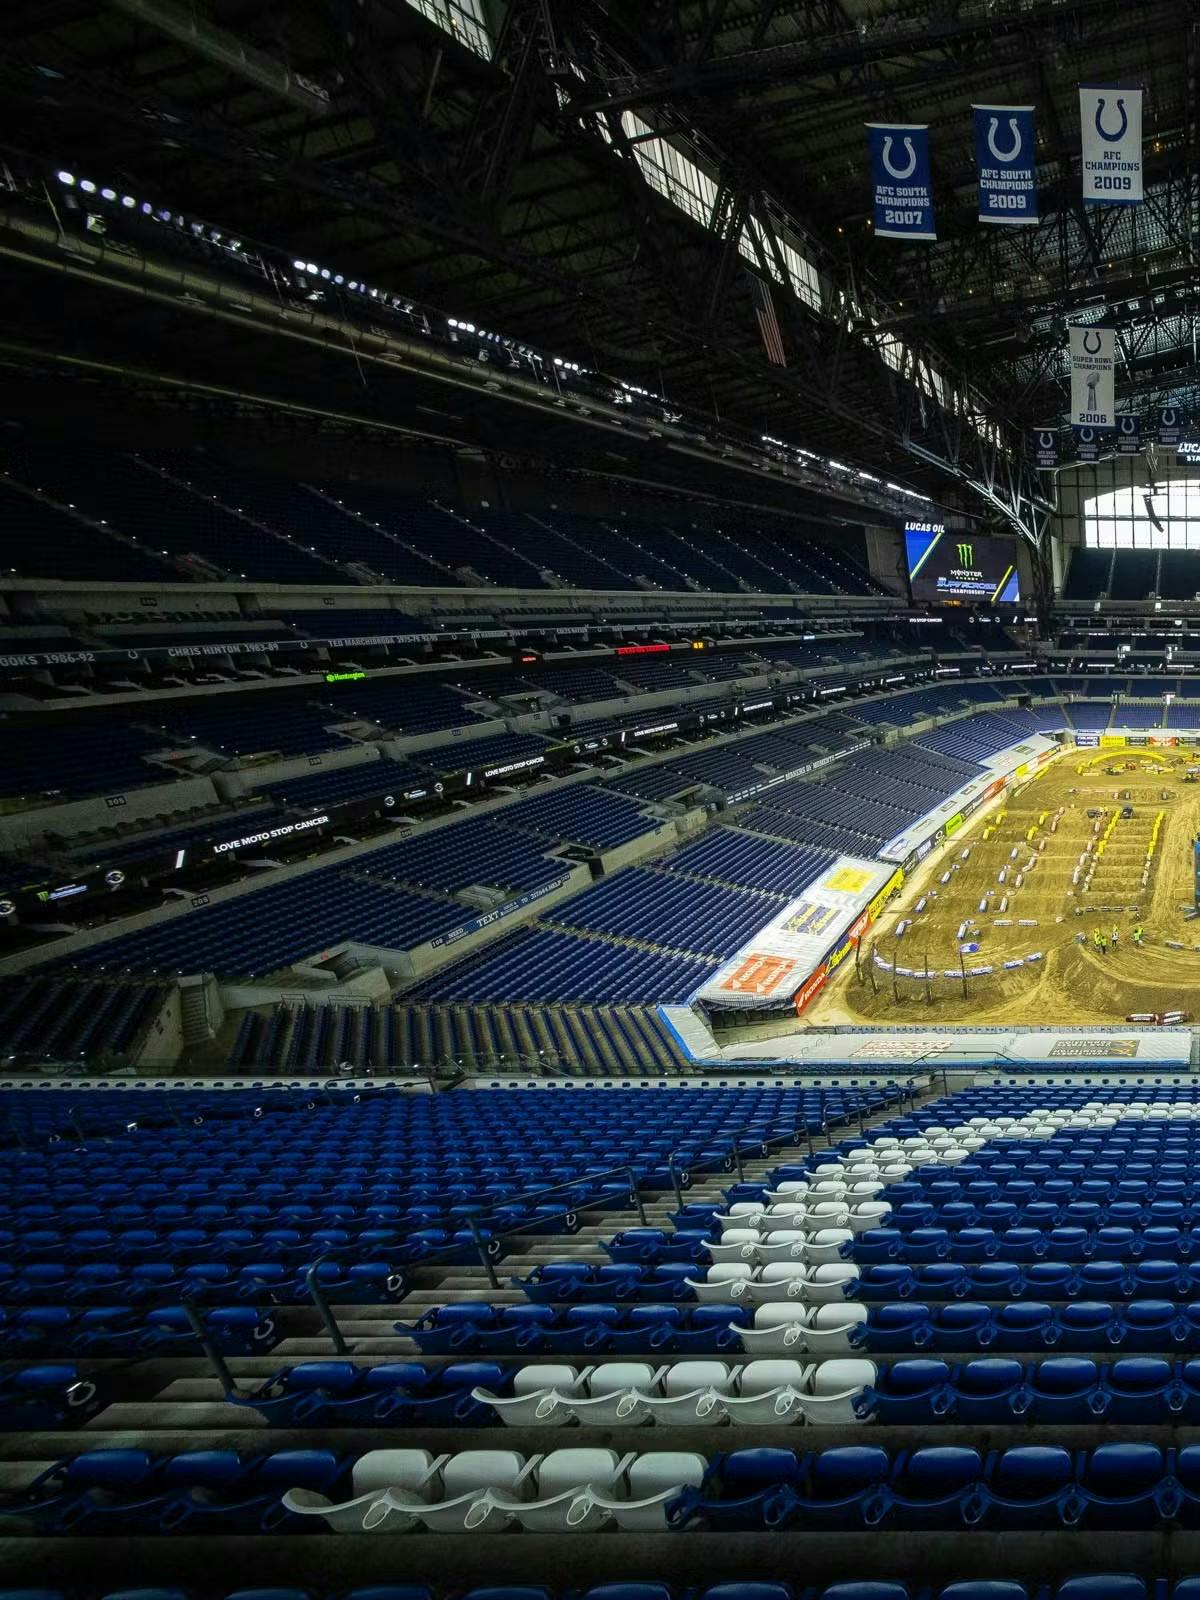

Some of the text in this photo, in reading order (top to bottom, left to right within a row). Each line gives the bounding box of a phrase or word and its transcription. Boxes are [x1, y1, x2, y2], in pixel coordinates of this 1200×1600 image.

[1103, 151, 1121, 160] AFC
[1085, 161, 1140, 171] CHAMPIONS
[981, 169, 1032, 180] AFC SOUTH
[980, 180, 1034, 190] CHAMPIONS
[1094, 176, 1131, 190] 2009
[876, 186, 928, 196] AFC SOUTH
[875, 196, 930, 207] CHAMPIONS
[989, 194, 1026, 208] 2009
[885, 210, 923, 225] 2007
[1073, 363, 1112, 371] CHAMPIONS
[1080, 413, 1107, 424] 2006
[905, 522, 945, 533] LUCAS OIL
[950, 569, 983, 577] MONSTER
[168, 648, 201, 657] CHRIS
[202, 645, 241, 655] HINTON
[44, 652, 96, 665] 1986-92
[485, 769, 499, 777] LOVE
[513, 761, 526, 770] STOP
[526, 756, 545, 766] CANCER
[213, 816, 329, 853] LOVE MOTO STOP CANCER
